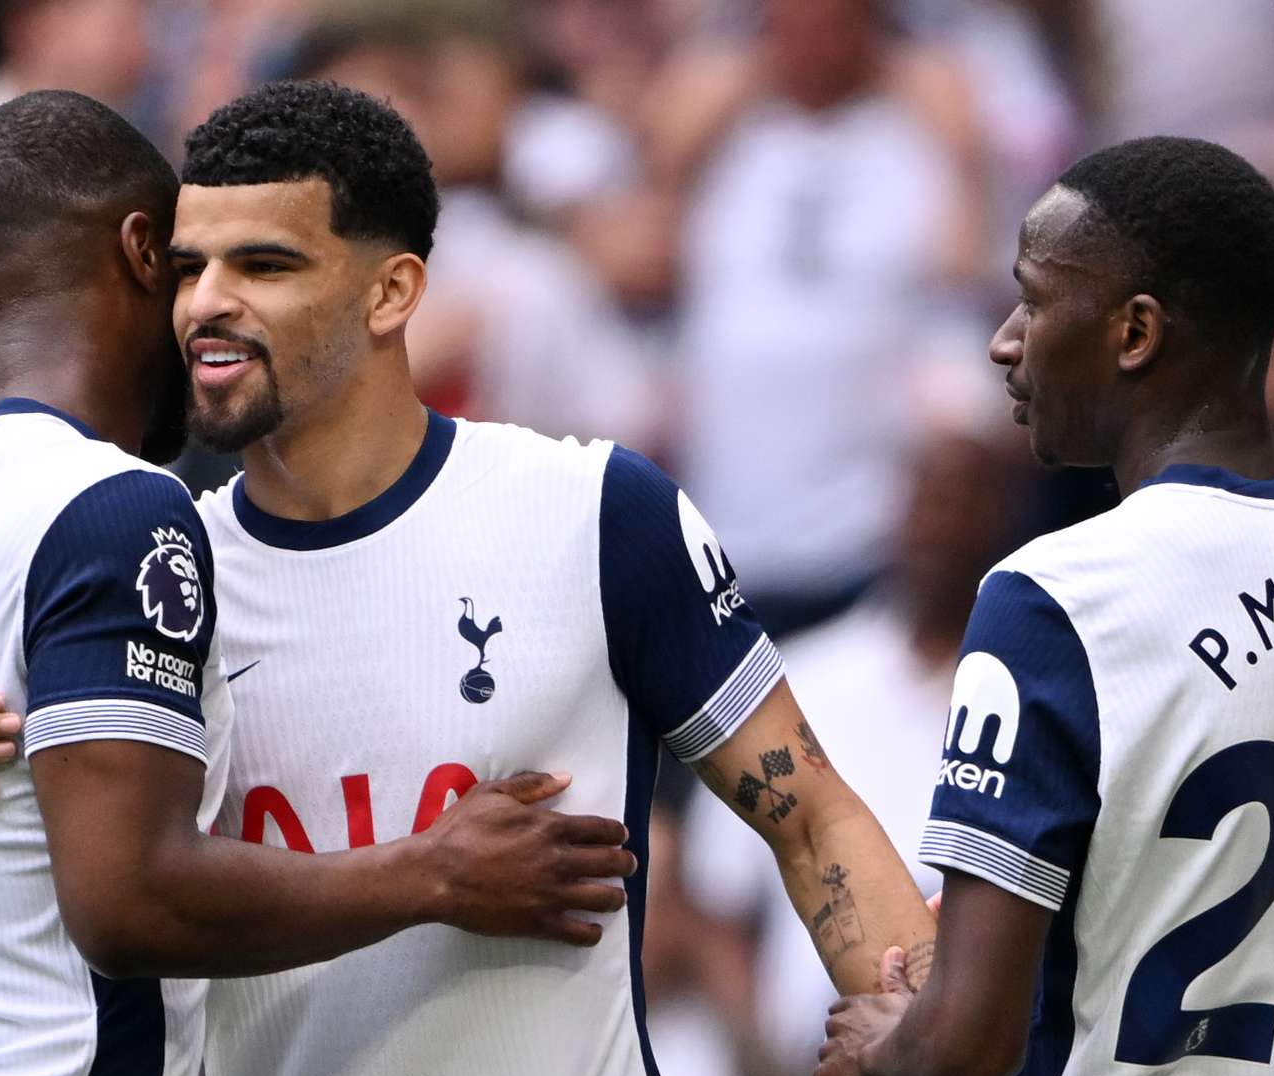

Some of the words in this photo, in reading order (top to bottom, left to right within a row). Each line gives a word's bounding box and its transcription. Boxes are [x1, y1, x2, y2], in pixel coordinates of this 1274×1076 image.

[127, 640, 156, 665] No
[157, 652, 194, 679] room
[155, 669, 196, 698] racism
